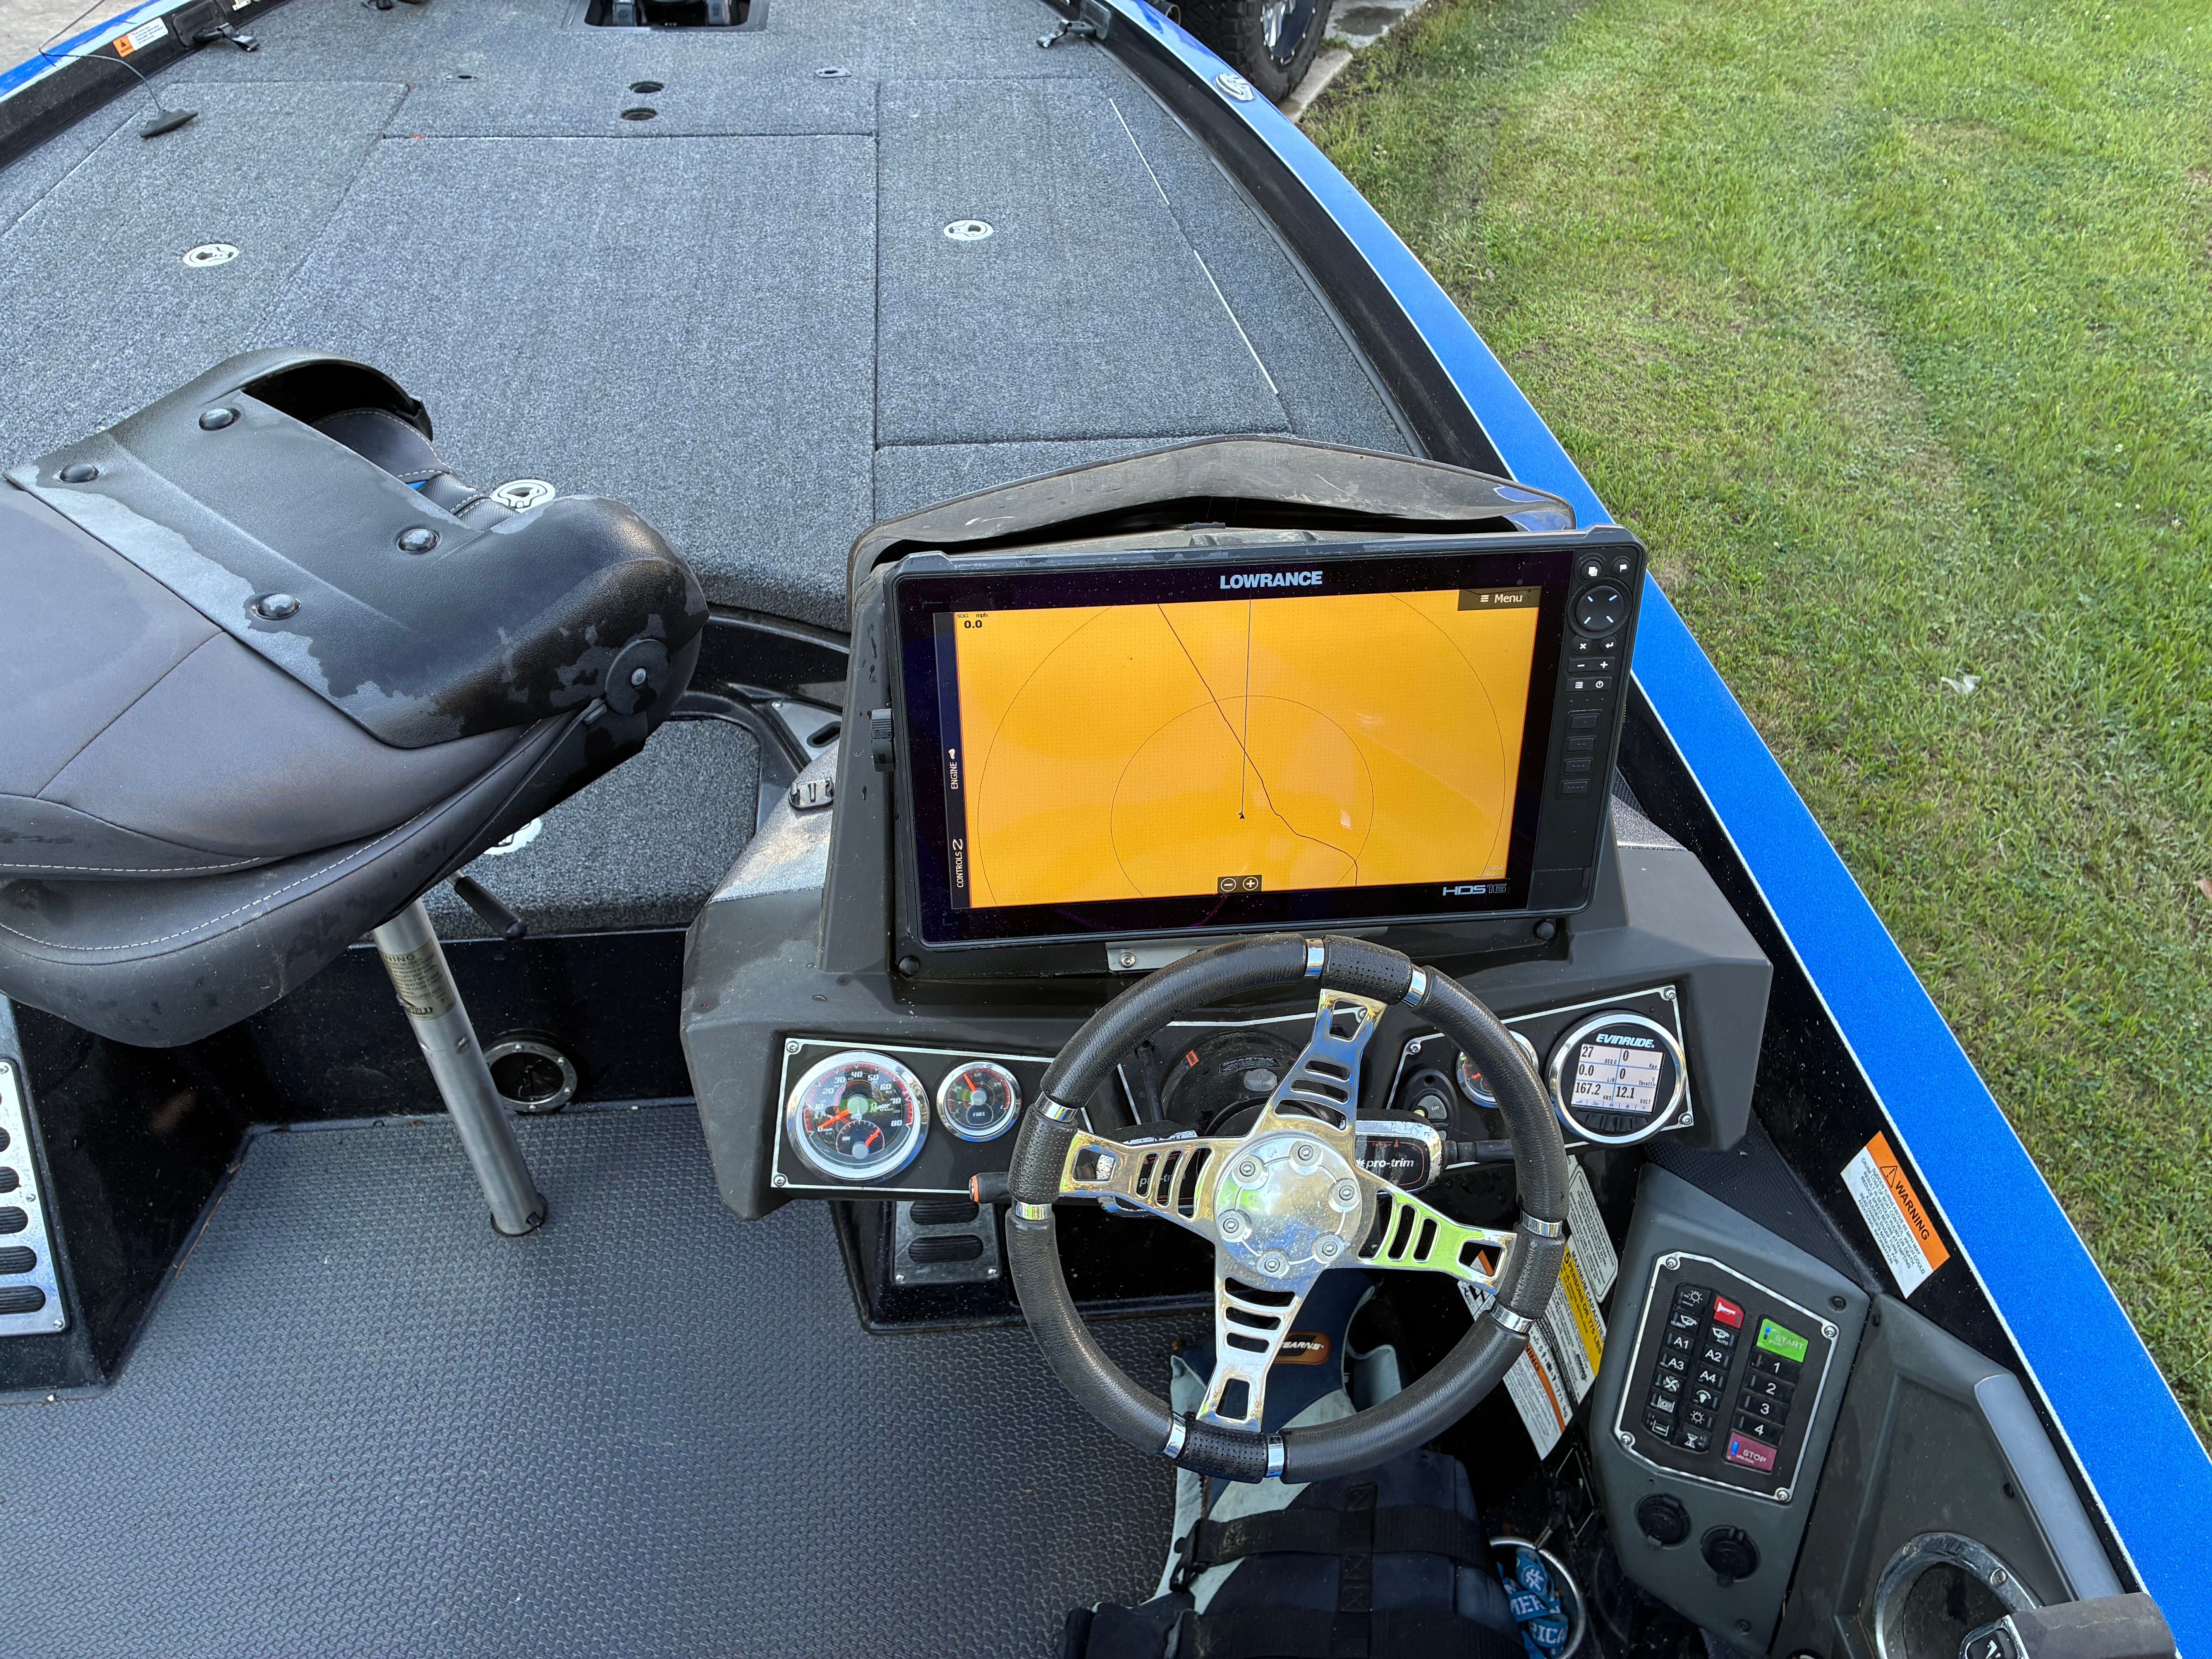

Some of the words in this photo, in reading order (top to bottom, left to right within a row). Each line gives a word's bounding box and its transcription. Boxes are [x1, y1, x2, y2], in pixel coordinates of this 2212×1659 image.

[1220, 571, 1323, 589] LOWRANCE
[1494, 594, 1522, 603] Menu
[964, 620, 982, 629] 0.0
[950, 762, 958, 789] ENGINE
[955, 852, 963, 888] CONTROLS
[1596, 1034, 1654, 1048] EVINRUDE
[1582, 1046, 1594, 1058] 27
[1623, 1050, 1629, 1061] 0
[1579, 1064, 1594, 1076] 0.0
[1620, 1068, 1626, 1079] 0
[1575, 1082, 1601, 1095] 167.2
[1616, 1086, 1635, 1099] 12.1
[1366, 1158, 1414, 1169] pro-trim
[1857, 1198, 1875, 1229] ADDITIONAL
[1863, 1170, 1875, 1191] RESULT
[1876, 1195, 1891, 1219] SERIOUS
[1889, 1218, 1900, 1238] INJURY
[1898, 1237, 1905, 1247] OR
[1872, 1167, 1885, 1190] SUDDEN
[1883, 1189, 1894, 1207] TURNS
[1892, 1206, 1903, 1224] ABOVE
[1906, 1231, 1914, 1244] MPH
[1912, 1243, 1920, 1256] MAY
[1896, 1180, 1930, 1240] WARNING
[1860, 1175, 1873, 1197] REDUCE
[1871, 1196, 1882, 1215] SPEED
[1881, 1214, 1894, 1236] BEFORE
[1891, 1235, 1911, 1269] ATTEMPTING
[1861, 1157, 1872, 1175] CAUSE
[1870, 1174, 1879, 1189] LOSS
[1877, 1188, 1883, 1197] OF
[1882, 1196, 1891, 1211] BOAT
[1903, 1236, 1915, 1255] WHICH
[1913, 1254, 1925, 1275] COULD
[1868, 1199, 1881, 1221] SUDDEN
[1879, 1220, 1890, 1240] SHARP
[1859, 1192, 1869, 1208] READ
[1867, 1207, 1881, 1231] OWNER'S
[1879, 1230, 1893, 1253] MANUAL
[1891, 1252, 1899, 1265] FOR
[1563, 1251, 1571, 1266] 5
[1568, 1261, 1584, 1304] PERSONS
[1582, 1302, 1589, 1317] OR
[1594, 1334, 1602, 1355] LBS
[1571, 1250, 1588, 1292] MAXIMUM
[1585, 1290, 1606, 1343] CAPACITIES
[1673, 1336, 1689, 1349] A1
[1776, 1335, 1805, 1349] START
[1705, 1349, 1722, 1362] A2
[1668, 1358, 1684, 1370] A3
[1774, 1362, 1780, 1373] 1
[1700, 1370, 1716, 1383] A4
[1766, 1382, 1776, 1395] 2
[1760, 1403, 1770, 1414] 3
[1754, 1424, 1764, 1436] 4
[1743, 1449, 1767, 1462] STOP
